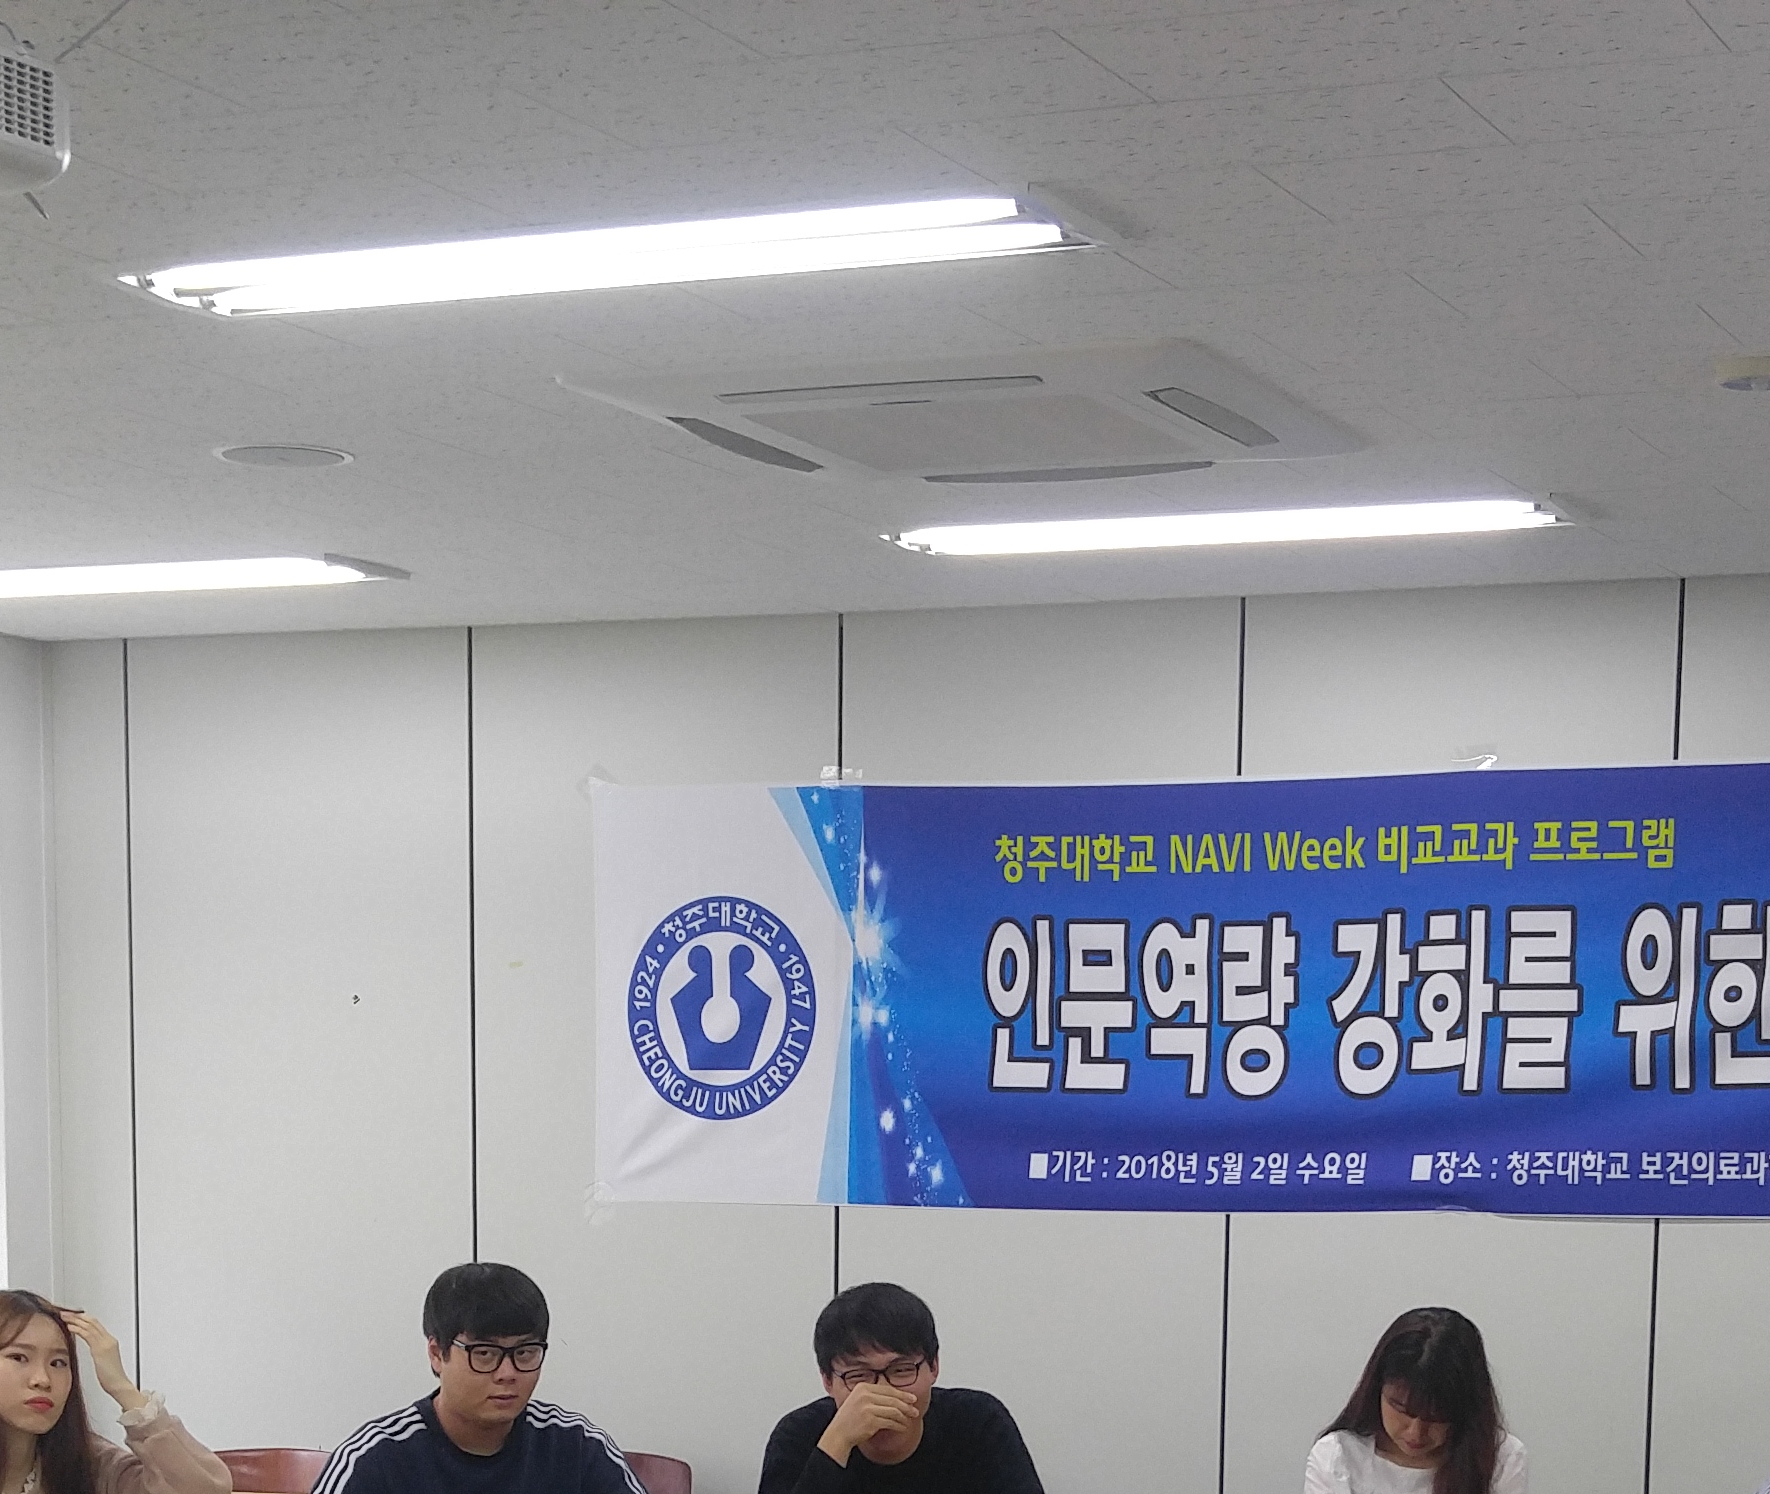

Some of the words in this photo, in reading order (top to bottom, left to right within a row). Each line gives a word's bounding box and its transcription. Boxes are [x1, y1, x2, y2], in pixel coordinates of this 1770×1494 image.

[995, 833, 1158, 883] 청주대학교
[1169, 833, 1251, 874] NAVI
[1263, 826, 1365, 871] Week
[1377, 822, 1519, 873] 비교교과
[1529, 818, 1676, 869] 프로그램
[660, 900, 781, 948] 청주대학교
[633, 954, 662, 1011] 1924
[781, 954, 811, 1010] 1947
[984, 915, 1299, 1097] 인문역량
[1329, 908, 1582, 1096] 강화를
[632, 1019, 709, 1113] CHEONGJU
[714, 1018, 810, 1115] UNIVERSITY
[1050, 1150, 1096, 1183] 기간
[1115, 1150, 1198, 1184] 2018년
[1204, 1152, 1243, 1185] 5월
[1250, 1152, 1289, 1185] 2일
[1295, 1152, 1367, 1185] 수요일
[1434, 1151, 1482, 1185] 장소
[1506, 1150, 1631, 1186] 청주대학교
